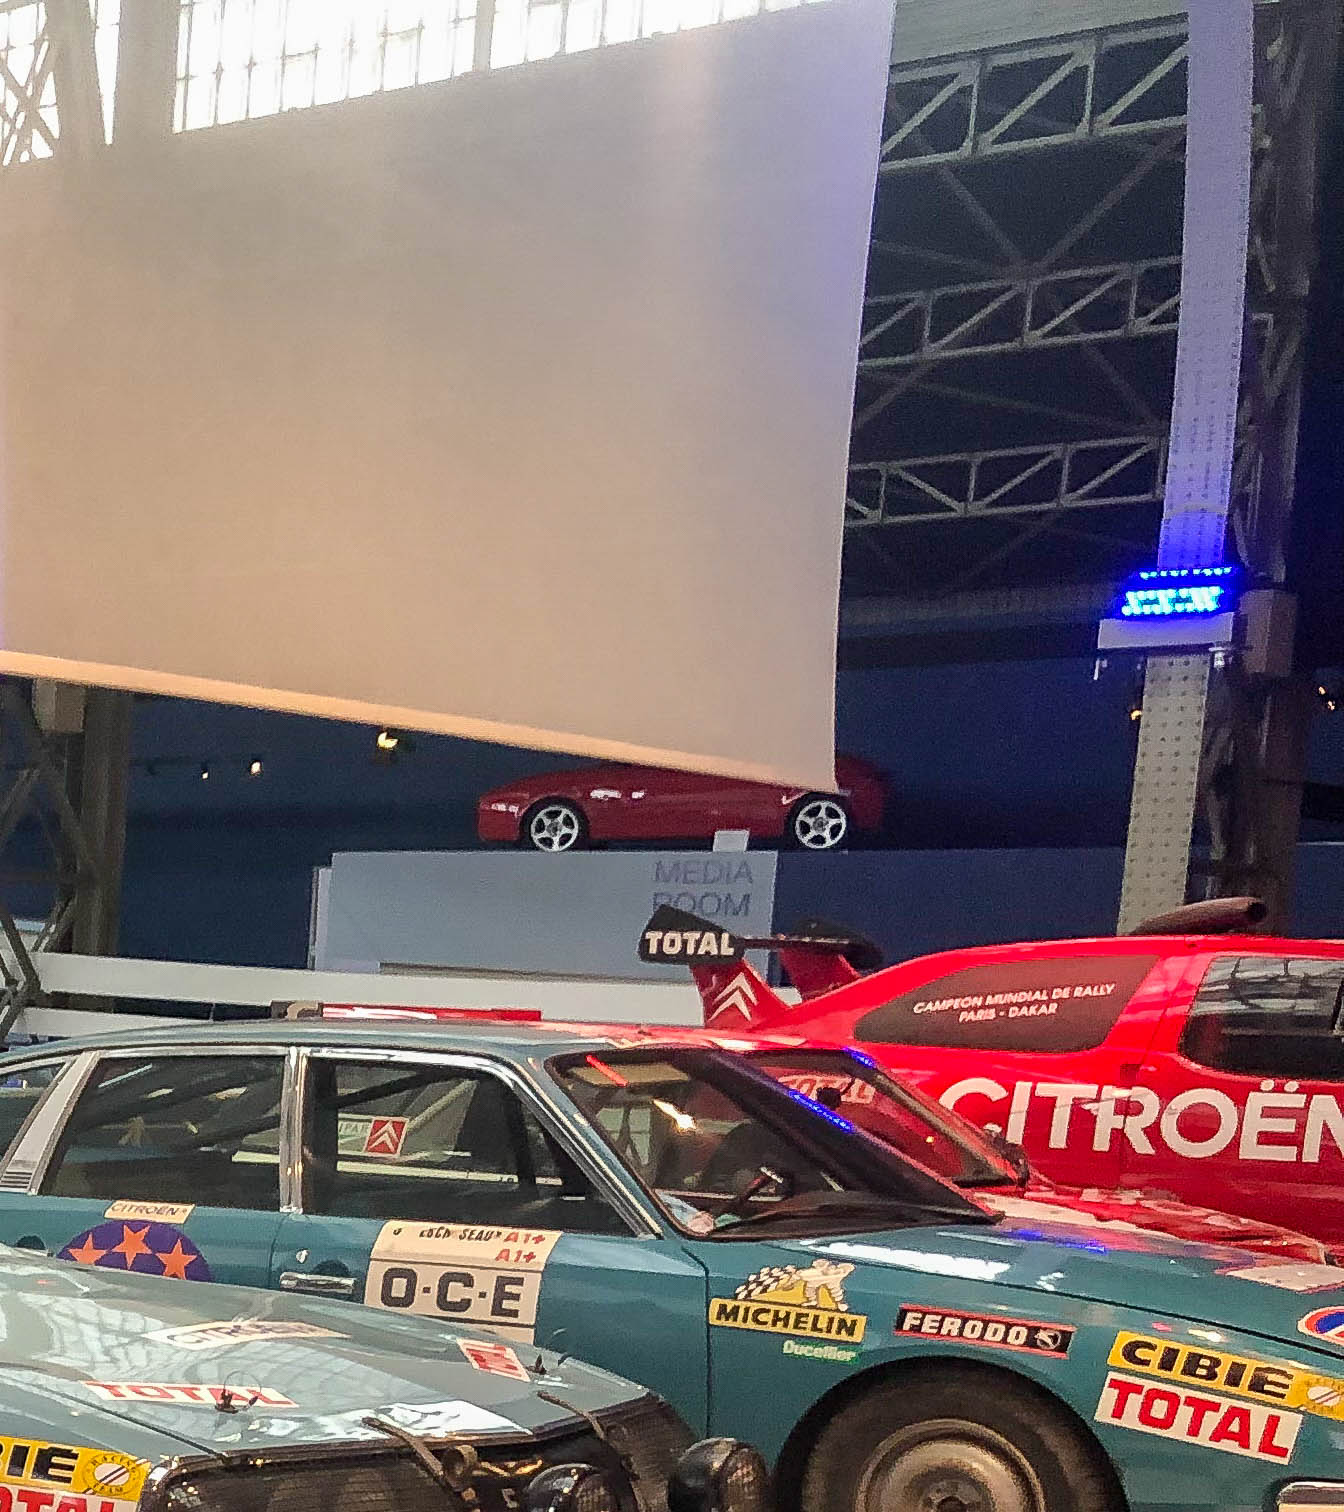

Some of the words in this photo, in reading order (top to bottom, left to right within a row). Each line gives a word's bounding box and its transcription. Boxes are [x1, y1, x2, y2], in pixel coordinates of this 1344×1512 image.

[654, 858, 753, 884] MEDIA
[645, 931, 735, 956] TOTAL
[985, 989, 1049, 1007] MUNDIAL
[1051, 986, 1071, 999] DE
[1073, 983, 1116, 997] RALLY
[958, 1007, 997, 1023] PARIS
[1008, 1002, 1058, 1018] DAKAR
[715, 1303, 859, 1338] MICHELIN
[902, 1311, 1029, 1346] FERODO
[85, 1382, 294, 1406] TOTAL
[1108, 1377, 1289, 1459] TOTAL
